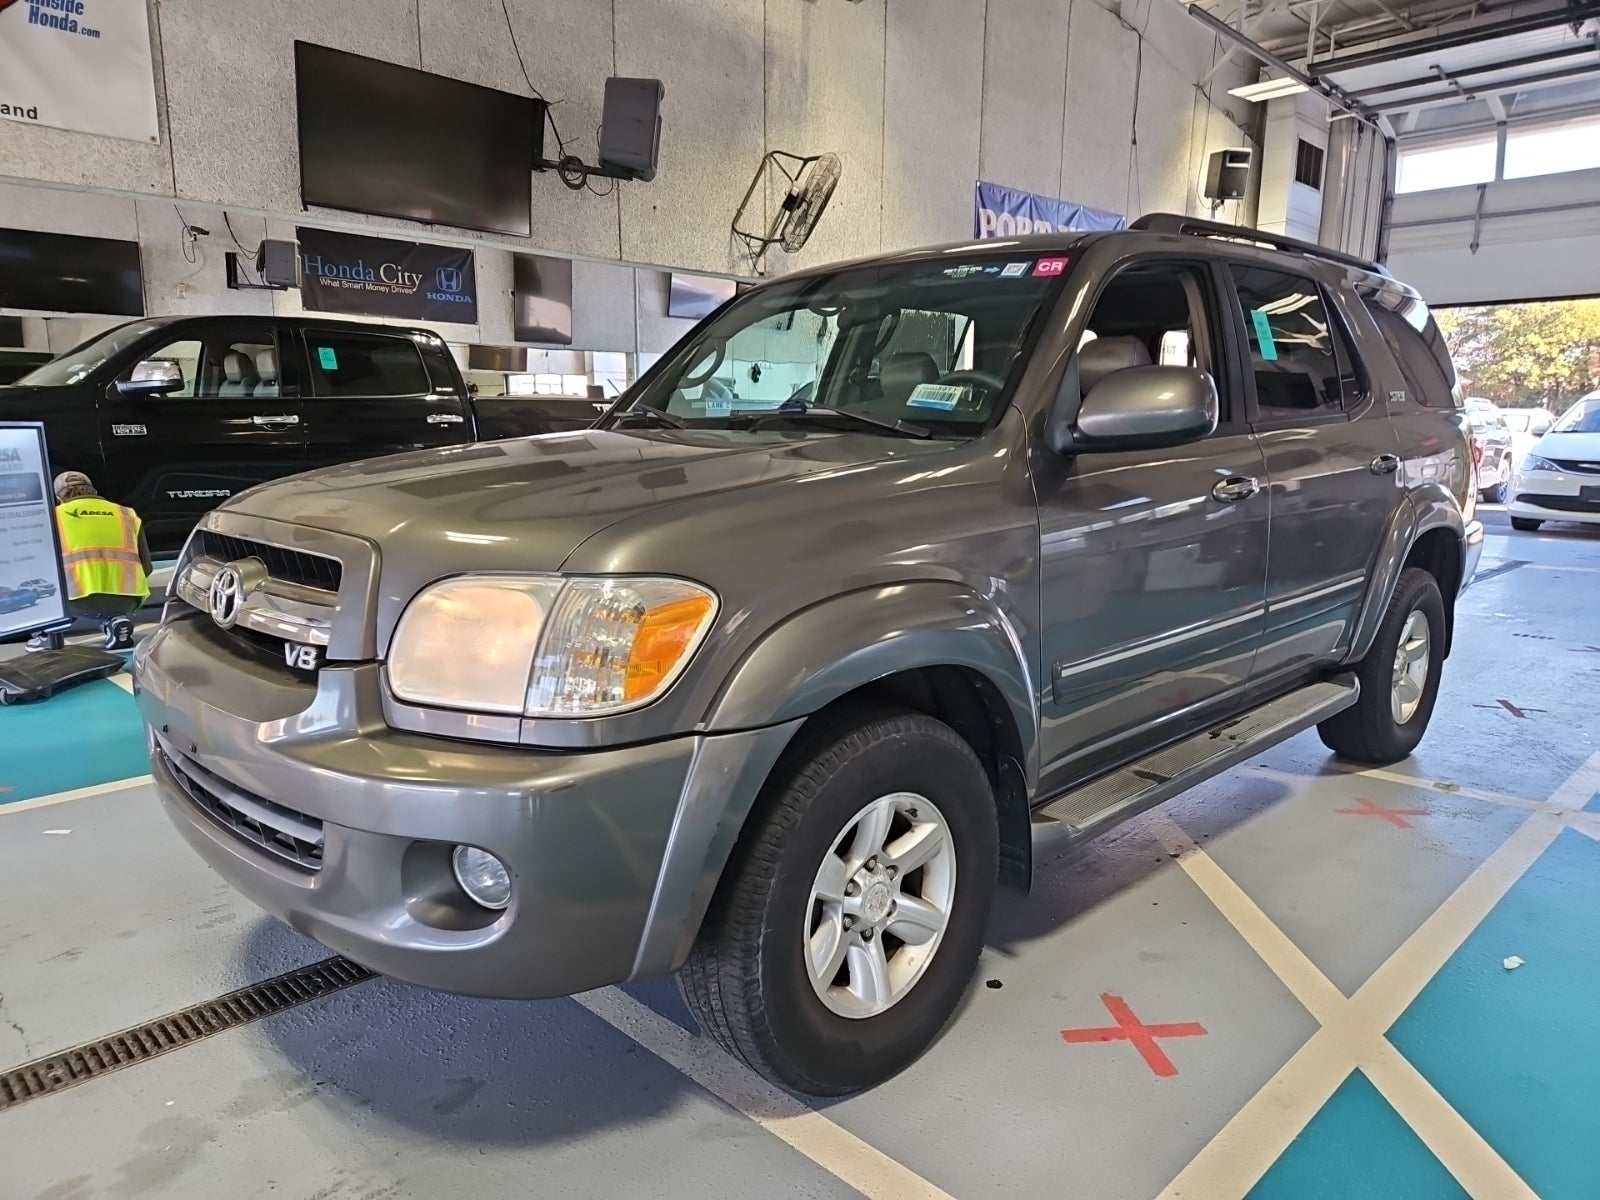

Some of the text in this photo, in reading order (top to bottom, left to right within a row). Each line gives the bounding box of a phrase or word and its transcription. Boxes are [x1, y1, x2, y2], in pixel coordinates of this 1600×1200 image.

[0, 104, 37, 120] and
[304, 254, 423, 291] Honda City
[1037, 261, 1063, 272] CR
[319, 277, 413, 295] What Smart Money Drives
[426, 292, 473, 303] HONDA
[166, 489, 231, 499] TUNDRA
[284, 642, 317, 671] V8
